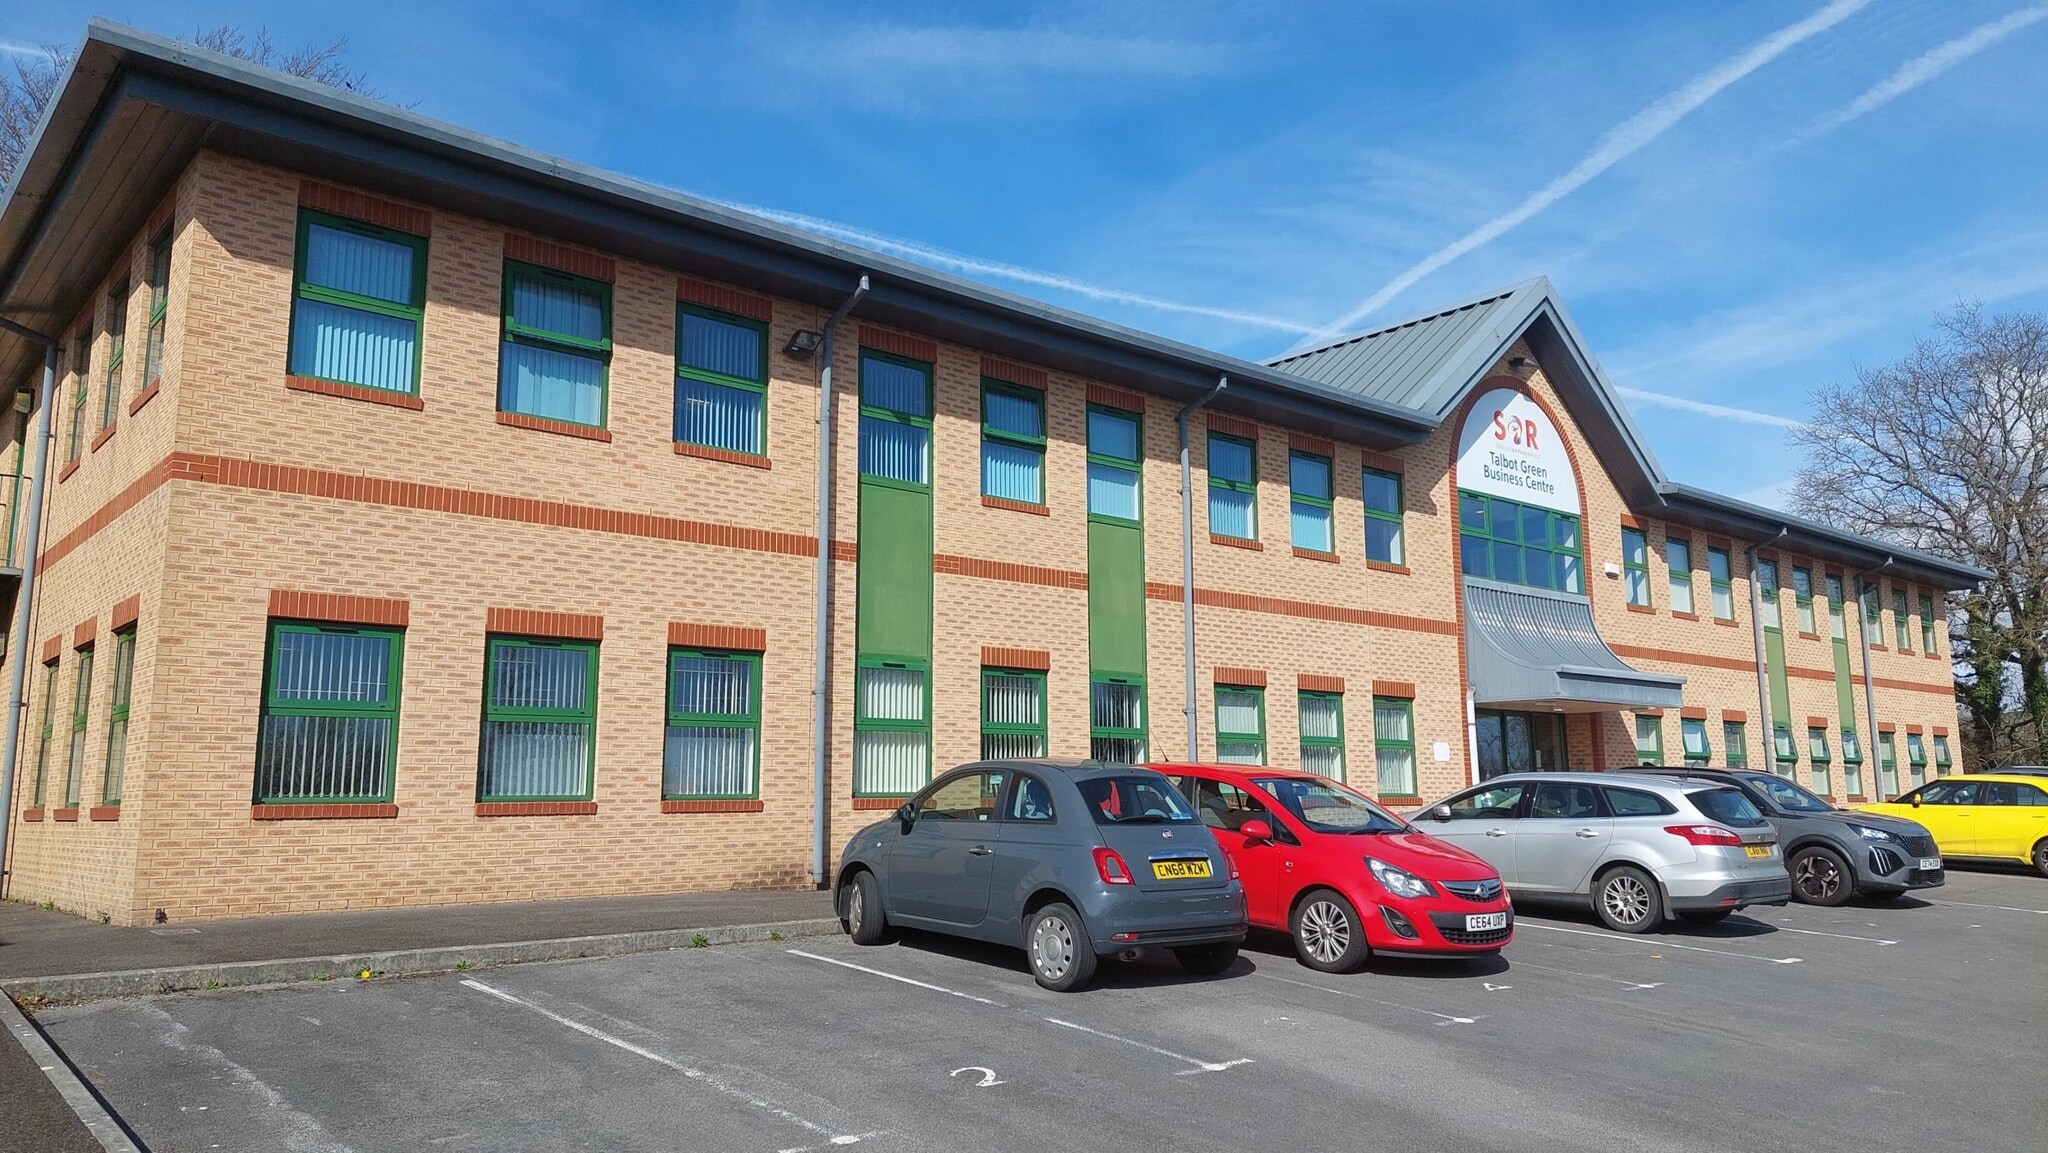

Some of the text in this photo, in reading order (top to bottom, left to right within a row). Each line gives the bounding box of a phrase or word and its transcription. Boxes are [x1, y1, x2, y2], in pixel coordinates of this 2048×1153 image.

[1489, 451, 1518, 471] Talbot
[1520, 460, 1547, 479] Green
[1483, 464, 1555, 495] Business Centre
[1158, 862, 1206, 877] CN68 WZM
[1470, 916, 1492, 929] CE64
